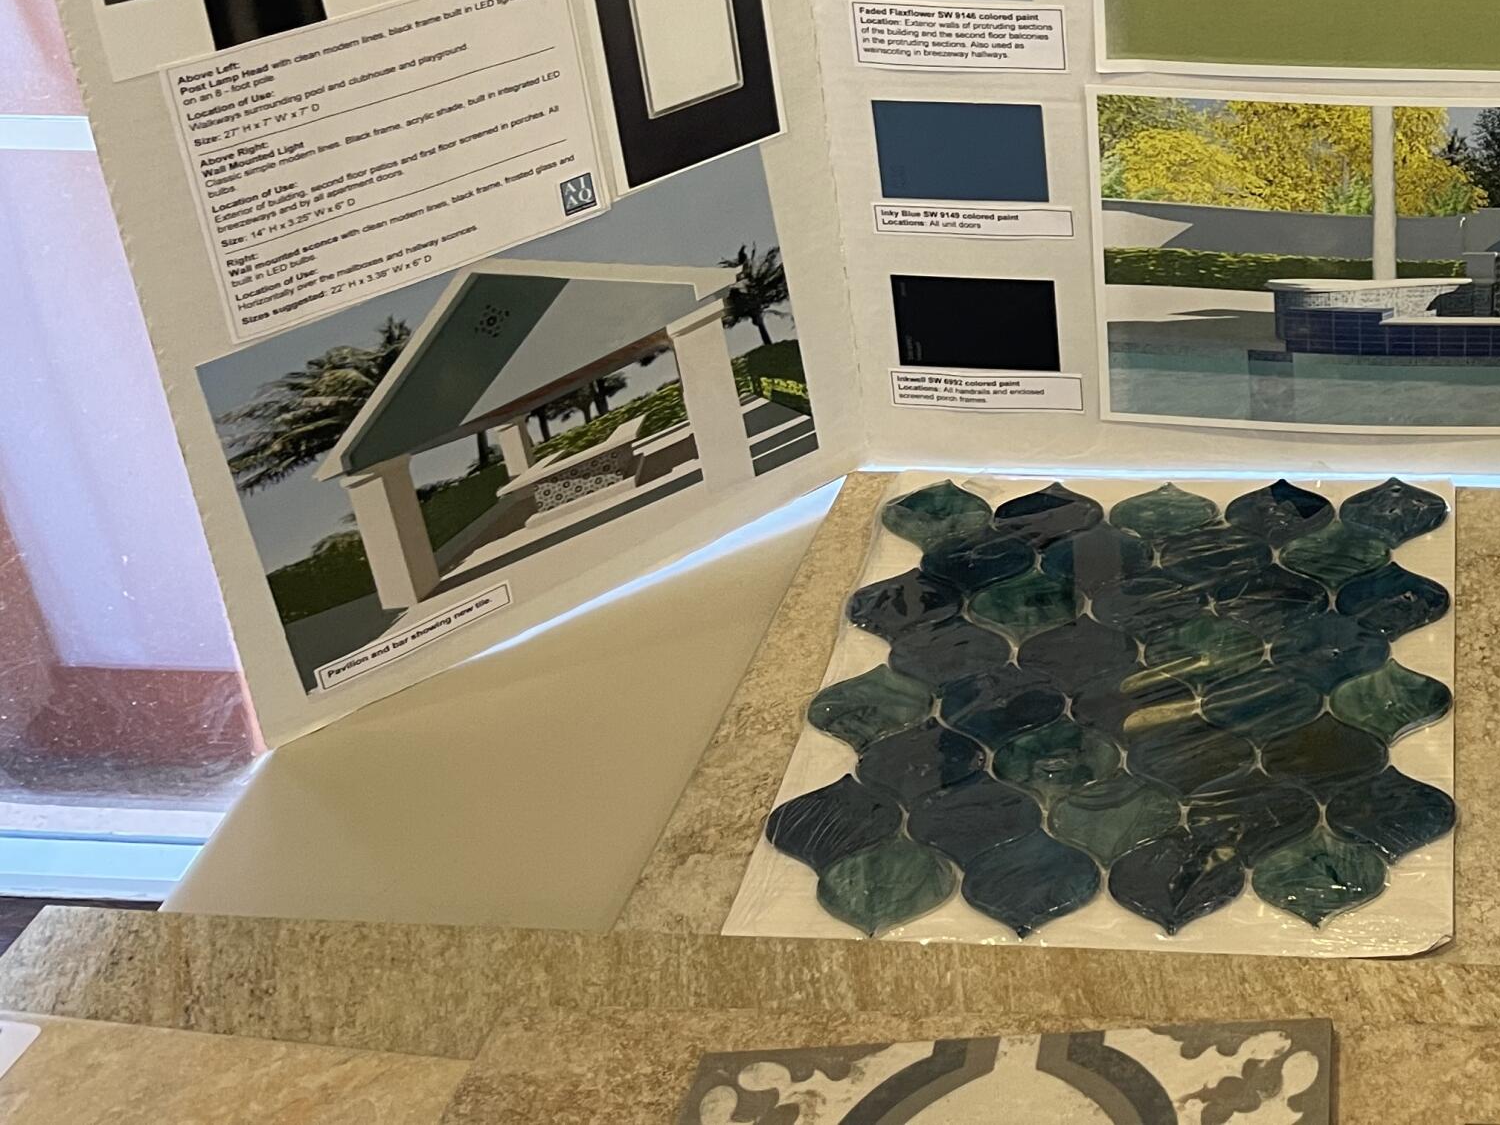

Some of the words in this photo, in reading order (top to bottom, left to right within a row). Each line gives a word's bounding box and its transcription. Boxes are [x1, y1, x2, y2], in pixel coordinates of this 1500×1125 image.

[177, 71, 214, 85] Above
[881, 210, 899, 218] Inky
[997, 214, 1019, 222] paint
[327, 656, 369, 678] Pavilion
[371, 645, 390, 659] and
[392, 637, 408, 649] bar
[411, 617, 452, 640] showing
[453, 606, 474, 619] new
